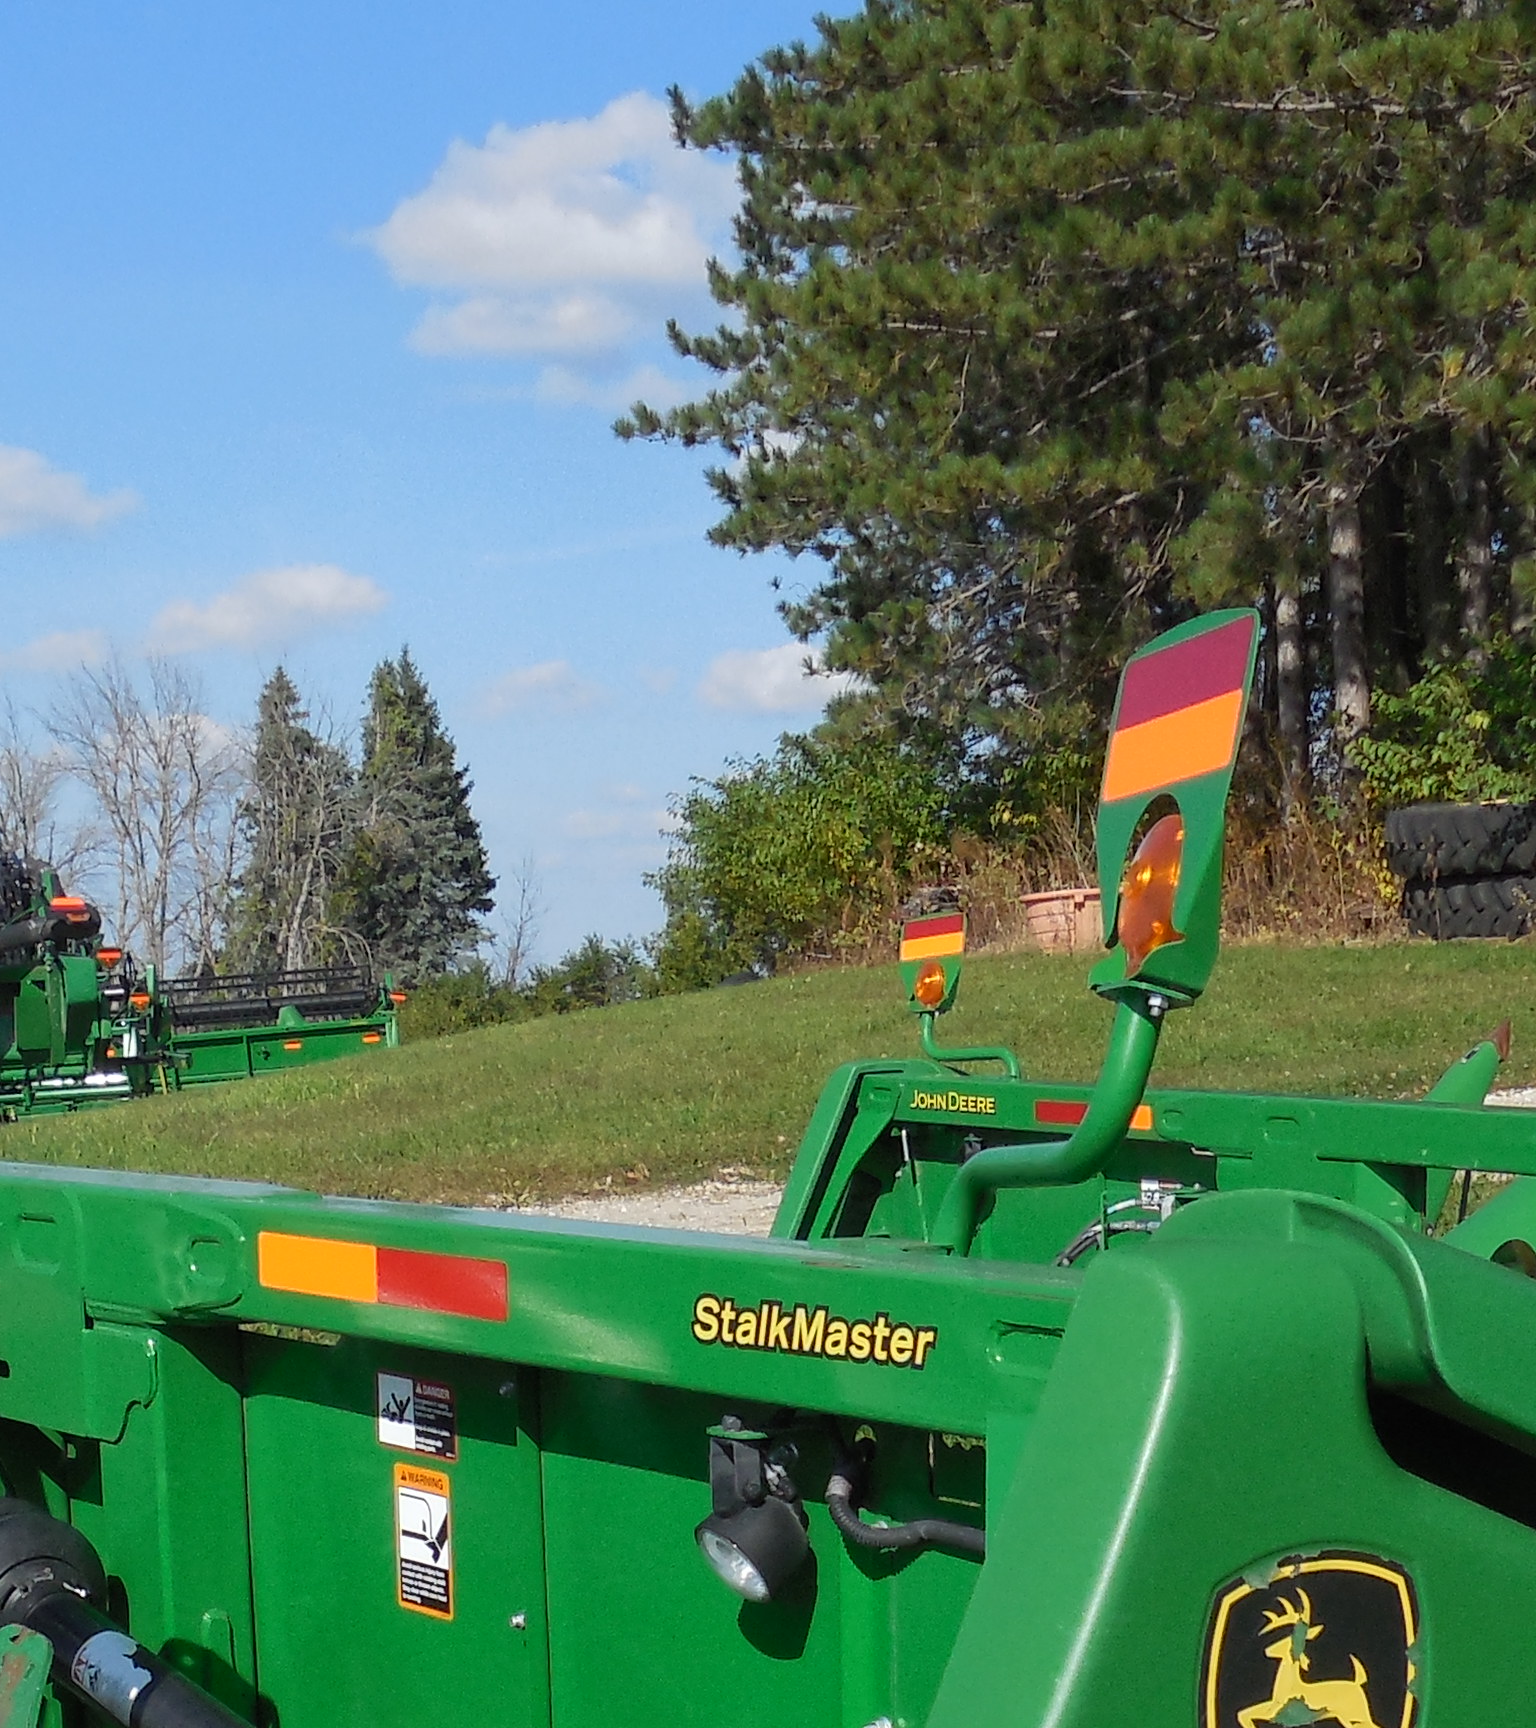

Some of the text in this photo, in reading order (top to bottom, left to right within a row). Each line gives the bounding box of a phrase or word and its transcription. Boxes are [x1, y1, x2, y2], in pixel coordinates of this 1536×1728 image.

[910, 1089, 996, 1115] JOHN DEERE
[693, 1292, 938, 1370] StalkMaster
[407, 1471, 444, 1491] WARNING
